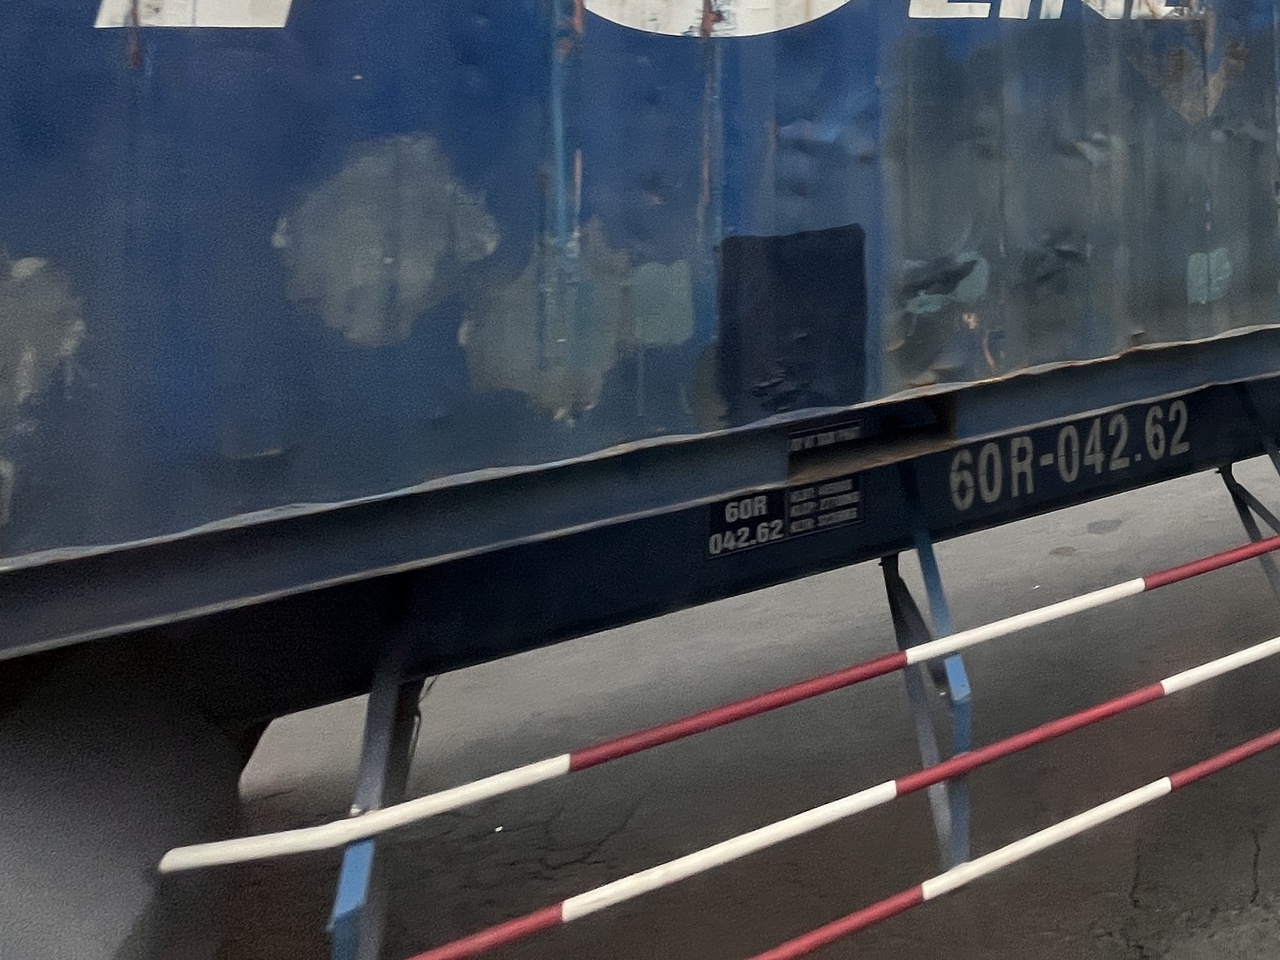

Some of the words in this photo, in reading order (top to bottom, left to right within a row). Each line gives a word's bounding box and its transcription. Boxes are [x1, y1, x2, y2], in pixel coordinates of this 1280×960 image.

[950, 400, 1190, 511] 60R-042.62
[725, 495, 768, 523] 60R
[708, 519, 785, 555] 042.62
